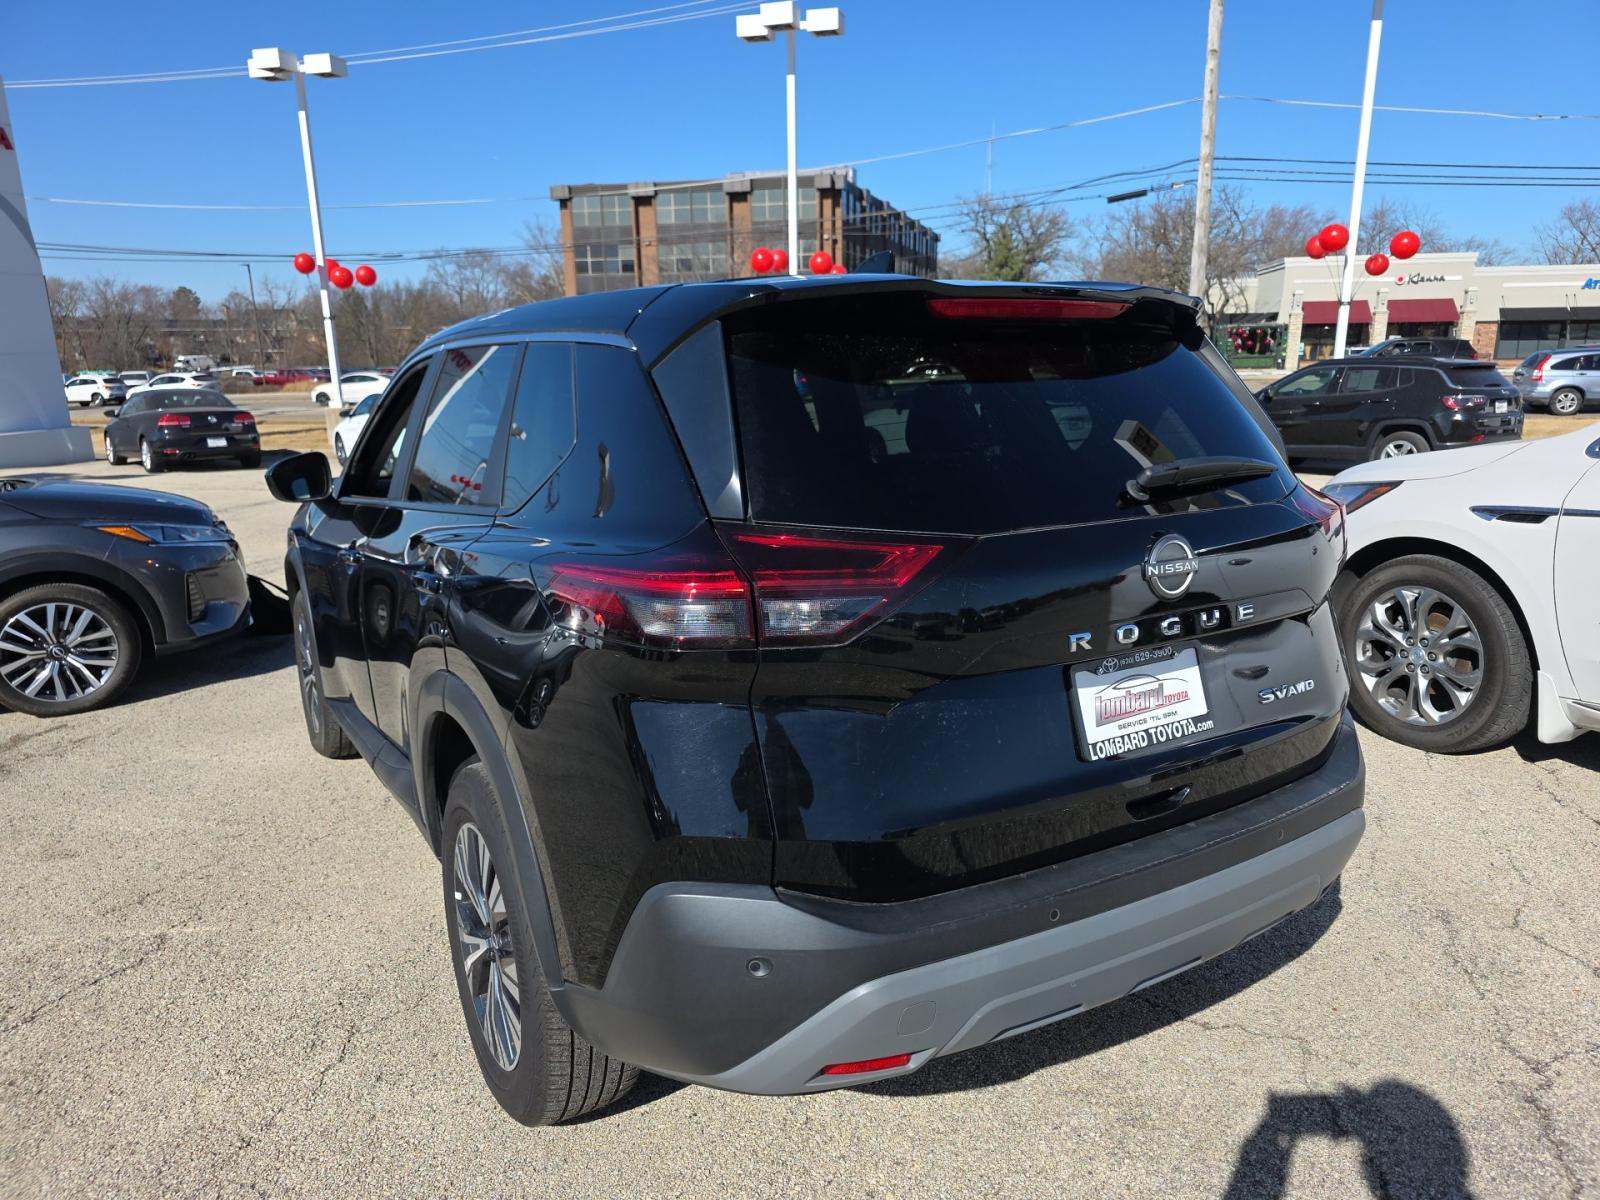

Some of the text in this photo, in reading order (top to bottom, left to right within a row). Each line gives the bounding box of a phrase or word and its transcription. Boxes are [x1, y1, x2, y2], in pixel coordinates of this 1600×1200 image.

[1147, 560, 1199, 577] NISSAN
[1067, 603, 1255, 653] ROGUE
[1134, 647, 1172, 662] 629-3900
[1094, 683, 1189, 728] lombard TOYOTA
[1117, 718, 1148, 731] SERVICE
[1088, 732, 1149, 761] LOMBARD
